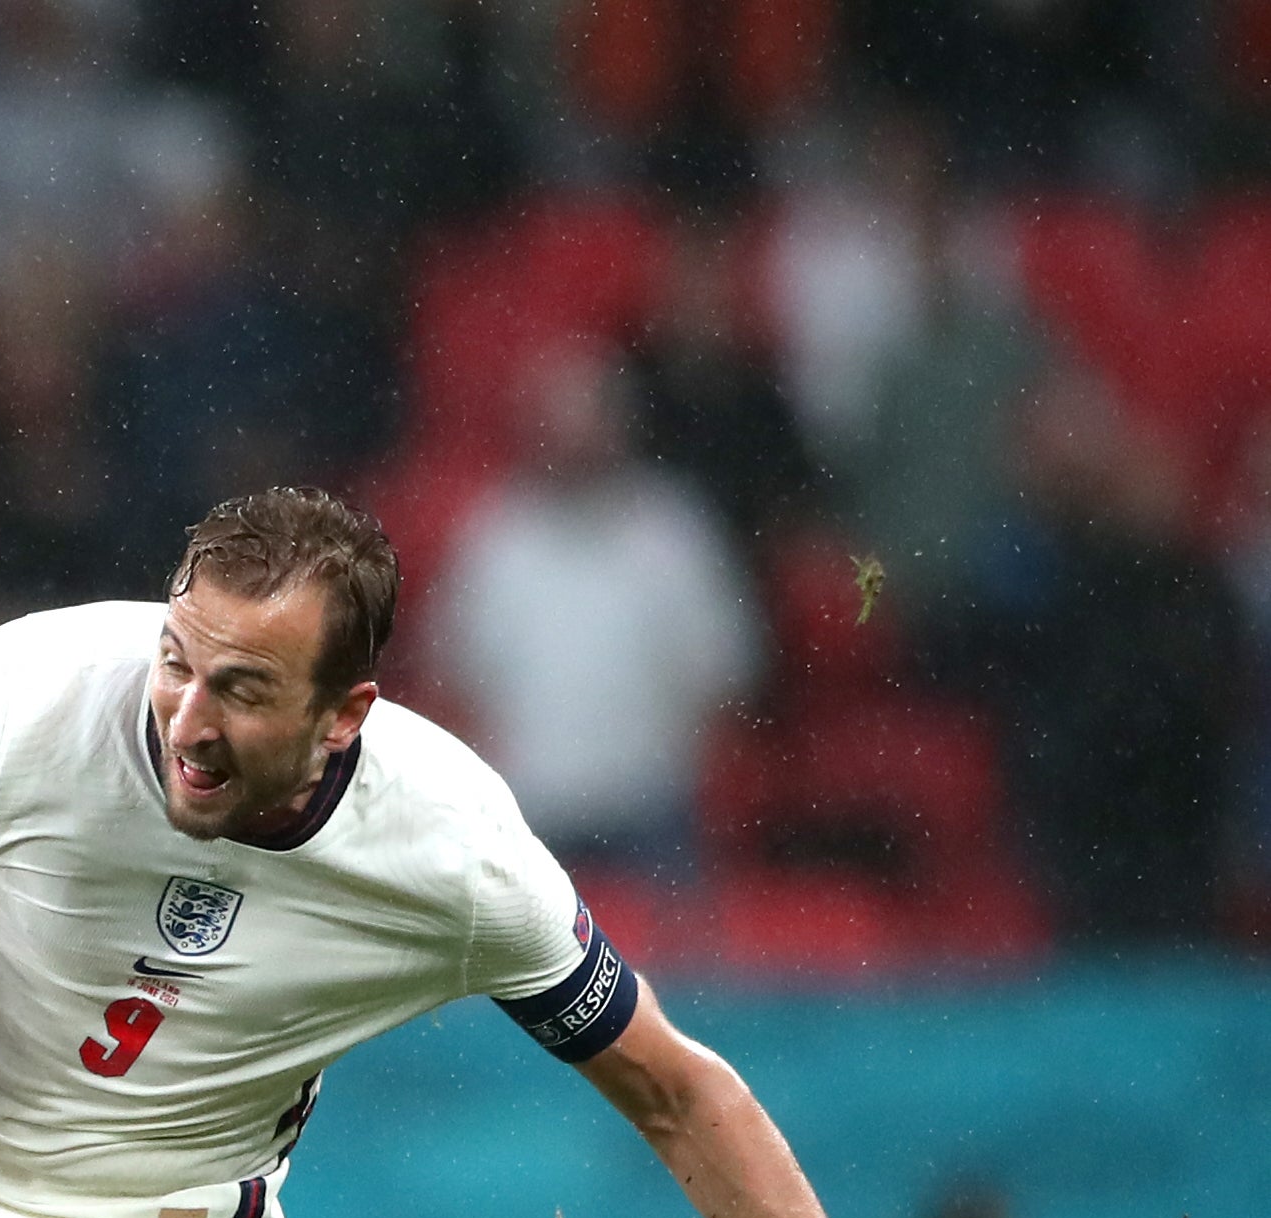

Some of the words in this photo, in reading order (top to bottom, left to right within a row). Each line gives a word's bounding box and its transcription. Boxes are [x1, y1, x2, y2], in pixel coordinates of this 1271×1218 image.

[137, 981, 160, 997] JUNE
[562, 947, 617, 1030] RESPECT
[79, 997, 165, 1077] 9
